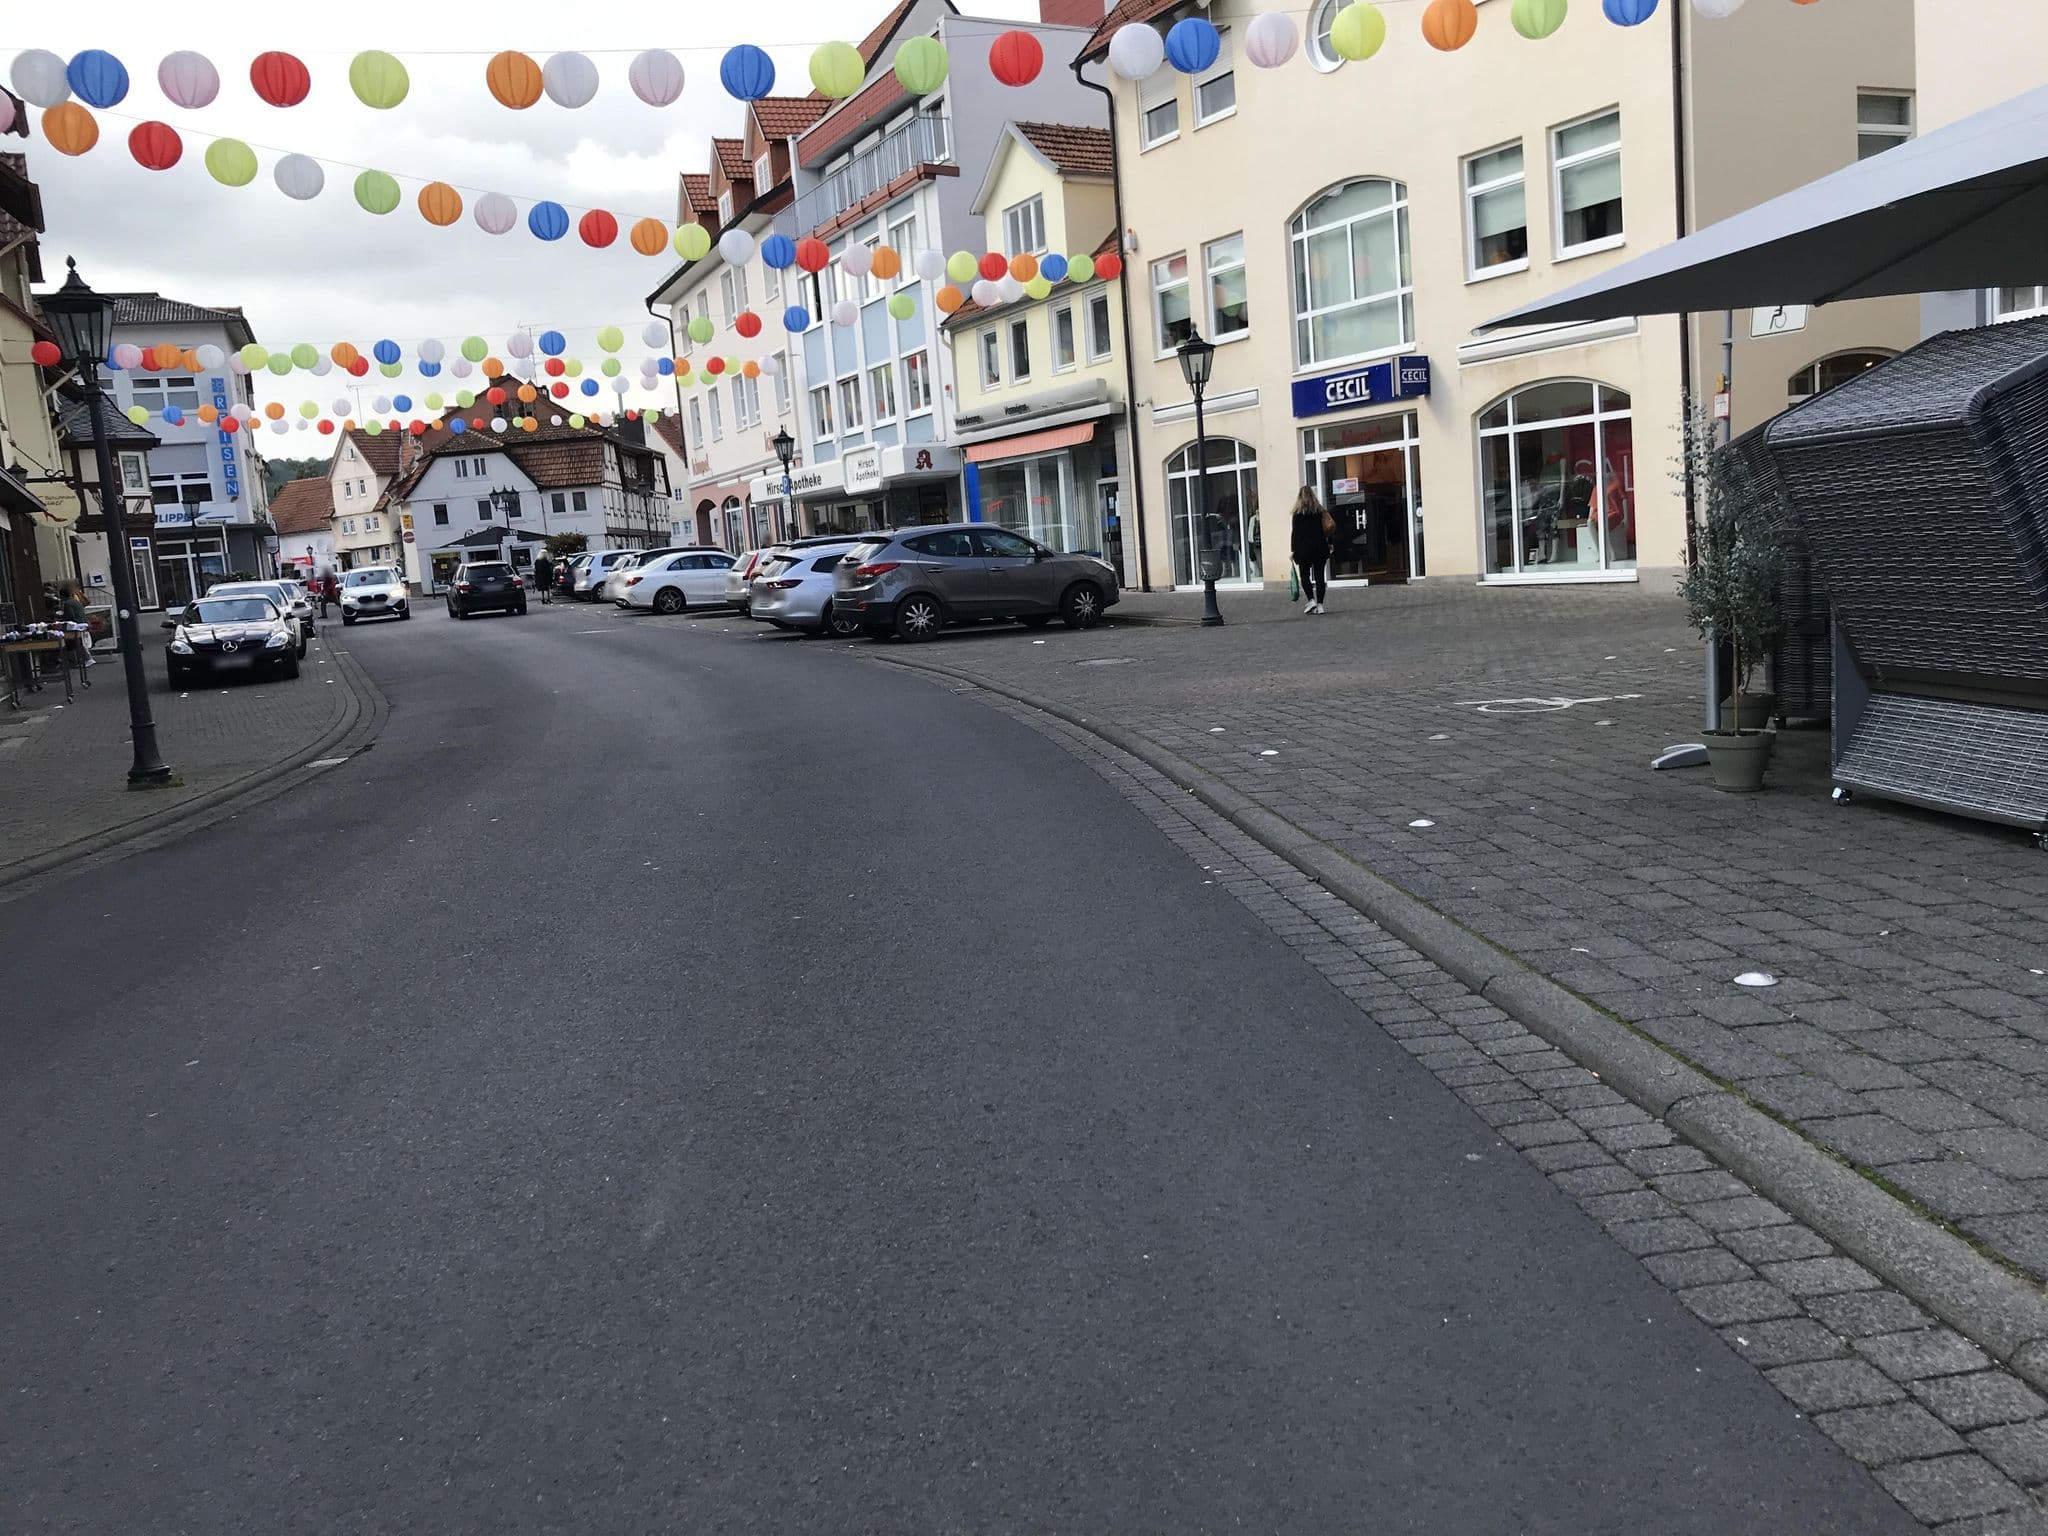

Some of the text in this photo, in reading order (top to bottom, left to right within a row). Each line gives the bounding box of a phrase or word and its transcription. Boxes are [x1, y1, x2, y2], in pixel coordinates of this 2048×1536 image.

[1402, 371, 1427, 381] CECIL
[1326, 378, 1370, 401] CECIL
[766, 482, 784, 496] Hirsc
